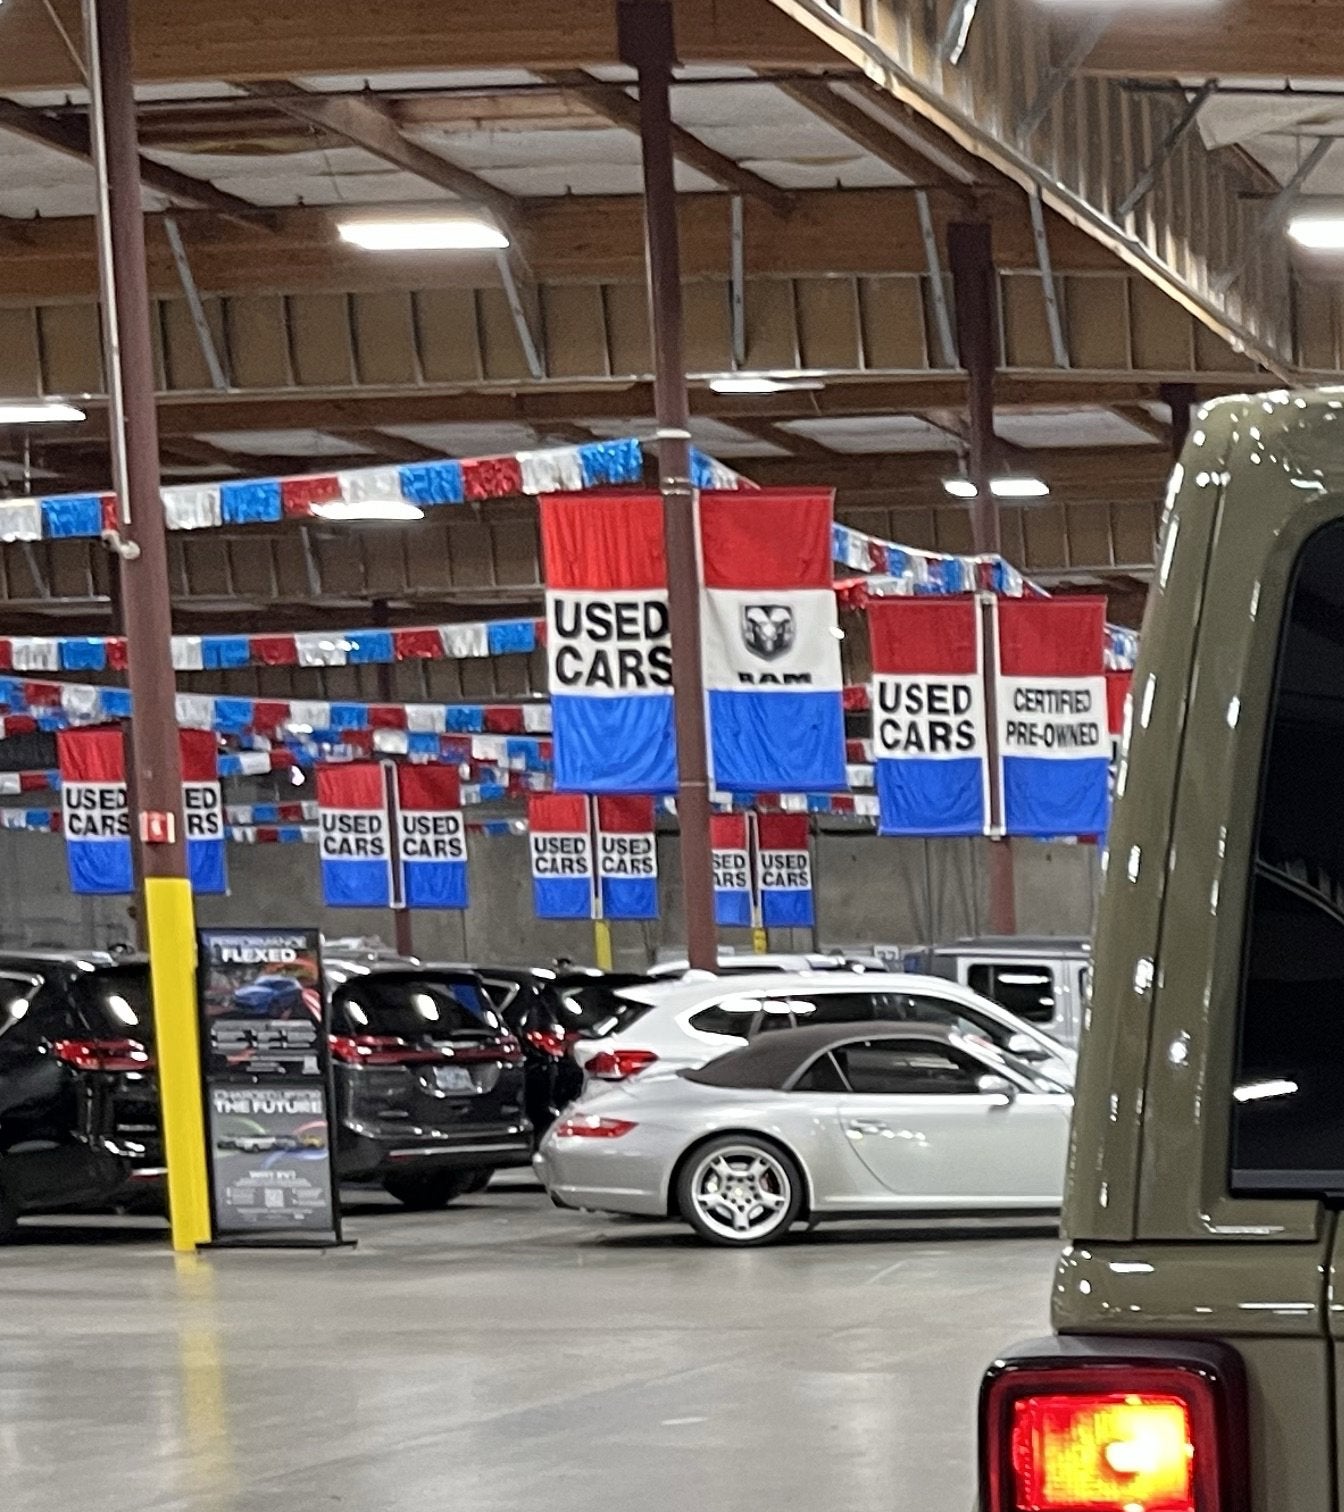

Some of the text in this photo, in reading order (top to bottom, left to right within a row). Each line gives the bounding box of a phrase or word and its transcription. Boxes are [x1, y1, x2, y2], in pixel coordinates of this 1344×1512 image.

[554, 599, 669, 642] USED
[555, 645, 673, 689] CARS
[737, 672, 812, 685] RAM
[878, 682, 972, 716] USED
[1013, 688, 1092, 714] CERTIFIED
[880, 719, 976, 752] CARS
[1006, 721, 1099, 747] PRE-OWNED
[66, 788, 128, 810] USED
[185, 788, 217, 809] ED
[68, 813, 129, 836] CARS
[187, 813, 218, 835] RS
[322, 814, 382, 834] USED
[403, 815, 459, 835] USED
[323, 837, 384, 856] CARS
[403, 838, 462, 857] CARS
[534, 837, 586, 854] USED
[602, 837, 652, 855] USED
[535, 856, 588, 874] CARS
[602, 856, 654, 874] CARS
[713, 854, 746, 869] SED
[761, 854, 807, 869] USED
[762, 872, 809, 888] CARS
[222, 948, 297, 962] FLEXED
